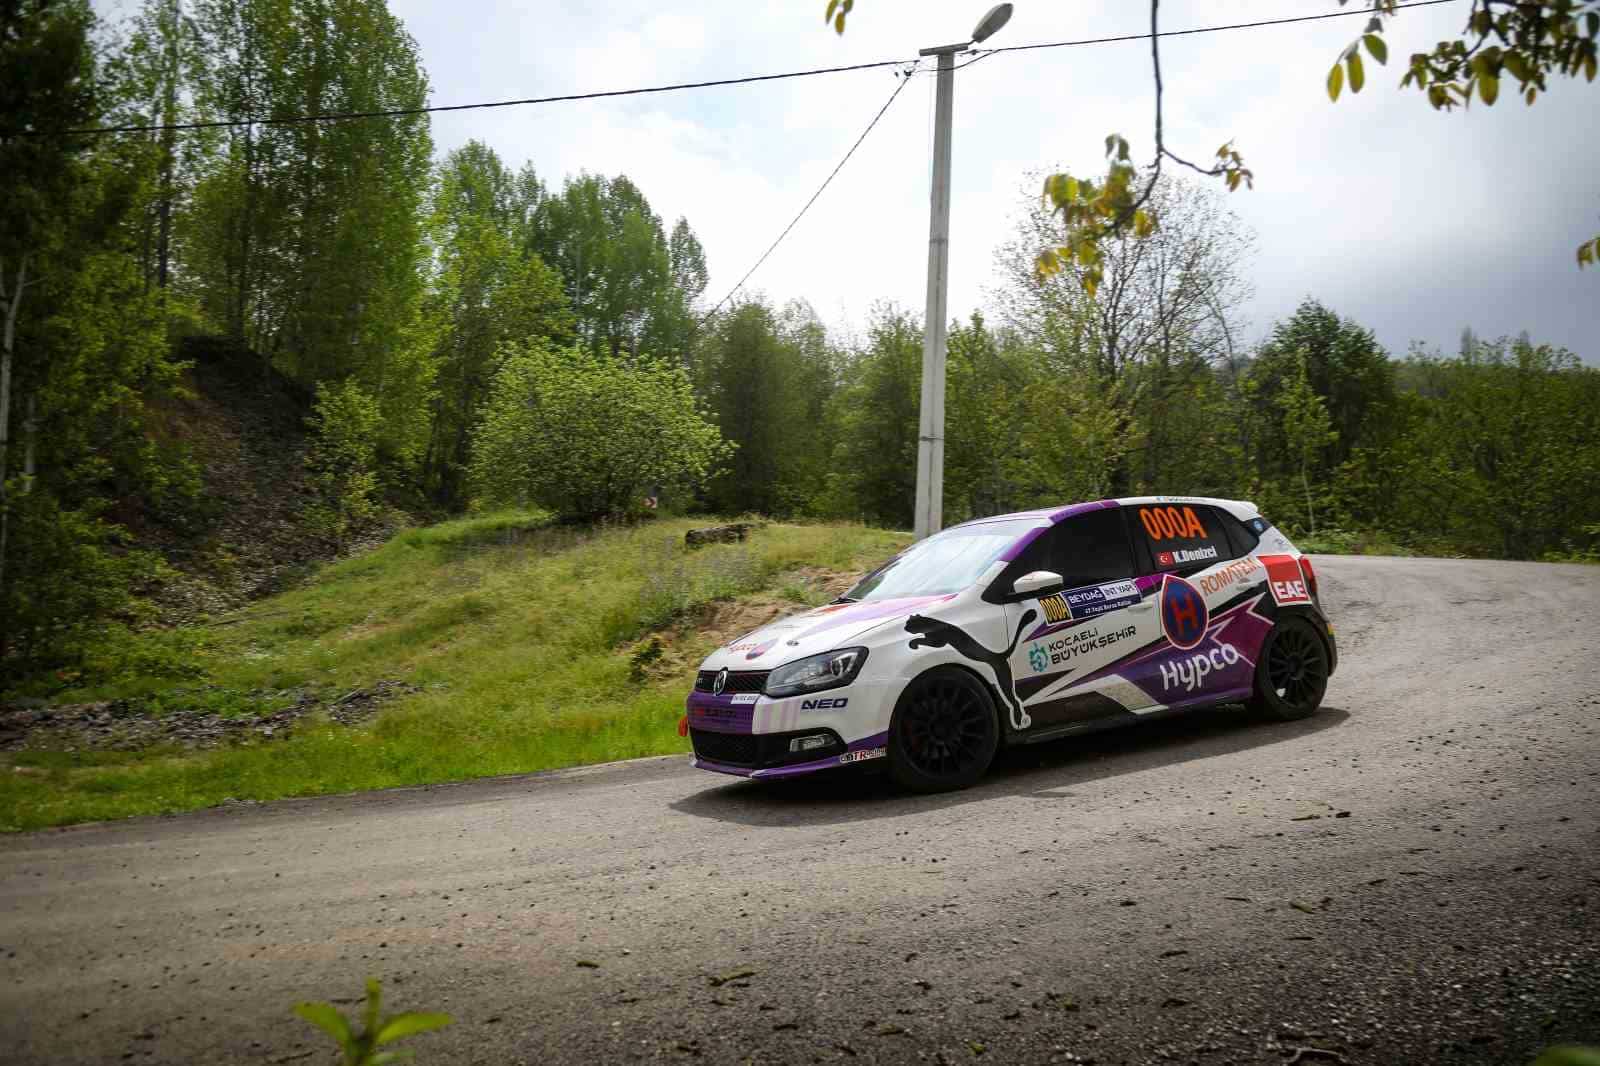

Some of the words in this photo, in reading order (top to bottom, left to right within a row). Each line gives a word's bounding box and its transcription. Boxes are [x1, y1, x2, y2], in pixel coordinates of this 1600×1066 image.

[1139, 506, 1208, 540] 000A
[1273, 580, 1306, 599] EAE
[1050, 625, 1137, 665] BÜYÜKŞEHİR
[1159, 643, 1240, 692] Hypco
[801, 697, 849, 711] NEO
